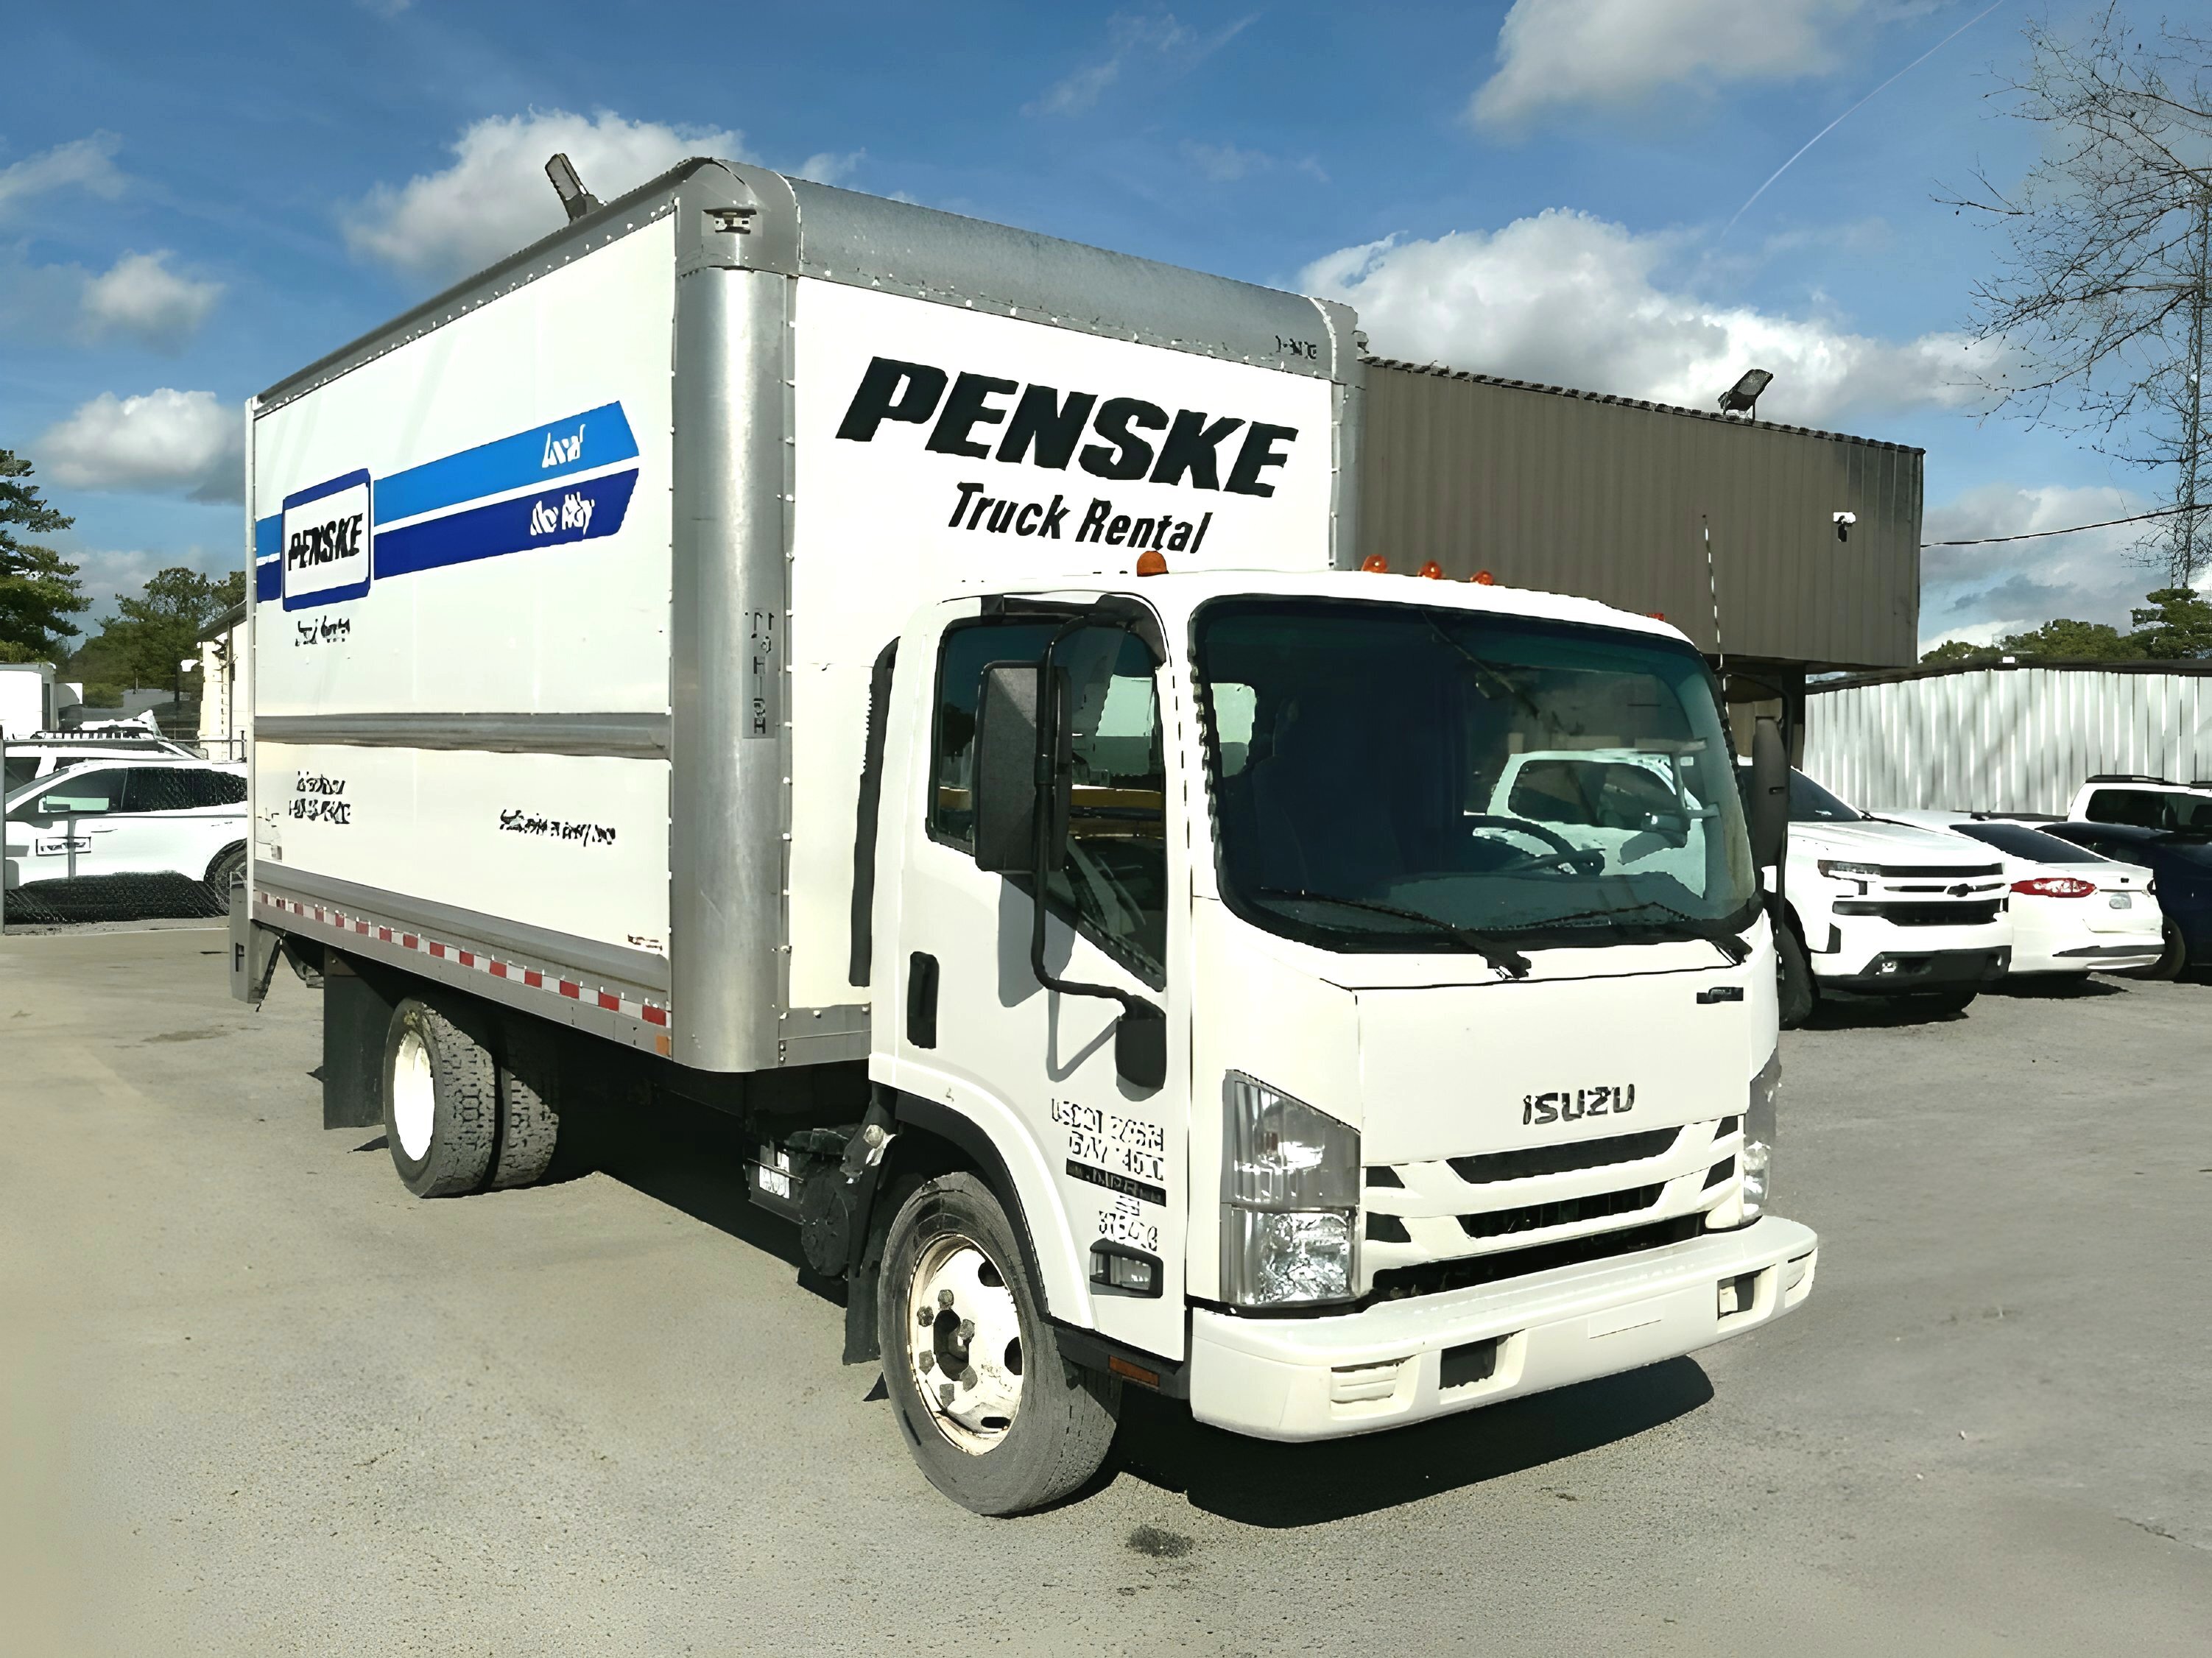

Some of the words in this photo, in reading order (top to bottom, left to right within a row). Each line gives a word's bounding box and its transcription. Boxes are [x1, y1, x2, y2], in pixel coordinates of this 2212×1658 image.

[835, 356, 1299, 498] PENSKE
[287, 514, 364, 571] PENSKE
[948, 481, 1071, 540] Truck
[1074, 497, 1214, 555] Rental
[1522, 1083, 1636, 1126] ISUZU
